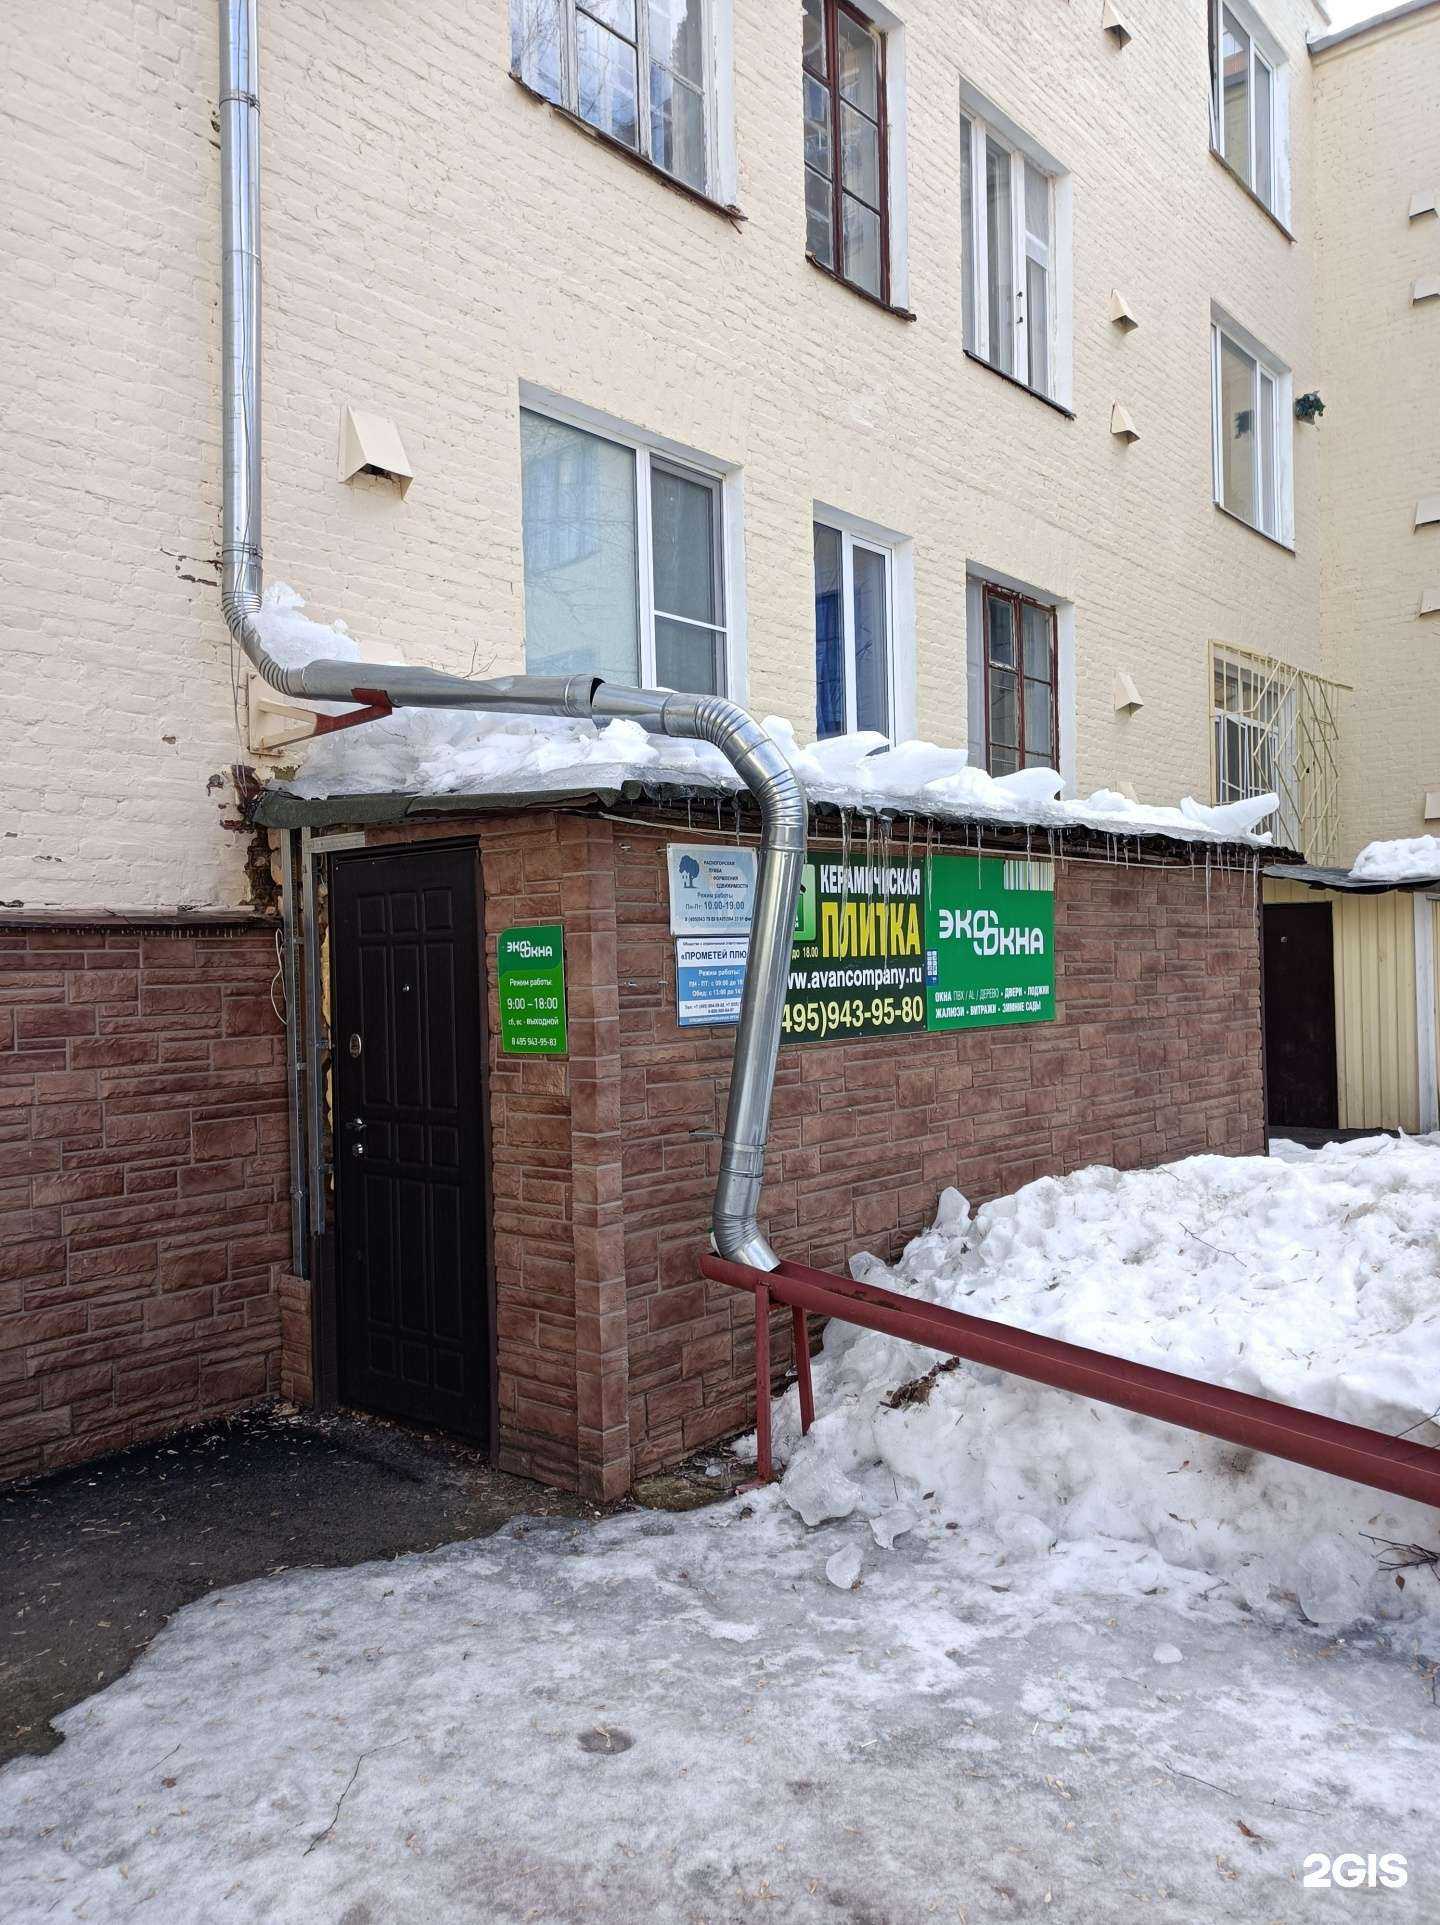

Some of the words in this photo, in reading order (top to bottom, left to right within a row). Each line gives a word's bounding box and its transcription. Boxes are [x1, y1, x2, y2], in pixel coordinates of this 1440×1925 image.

[704, 901, 745, 910] 10.00-19.00
[821, 901, 921, 958] ПЛИТКА
[729, 950, 748, 960] ПЛЮ
[509, 978, 529, 987] Режим
[935, 991, 951, 1002] ОКНА
[1004, 987, 1023, 999] ДВЕРИ
[507, 998, 525, 1010] 9:00
[534, 997, 558, 1010] 18:00
[935, 1006, 965, 1019] ЖАЛЮЗИ
[970, 1003, 997, 1016] ВИТРАЖИ
[1002, 1002, 1024, 1013] ЗИМНИЕ
[1025, 1000, 1041, 1012] САДЫ
[782, 995, 924, 1038] 495)943-95-80
